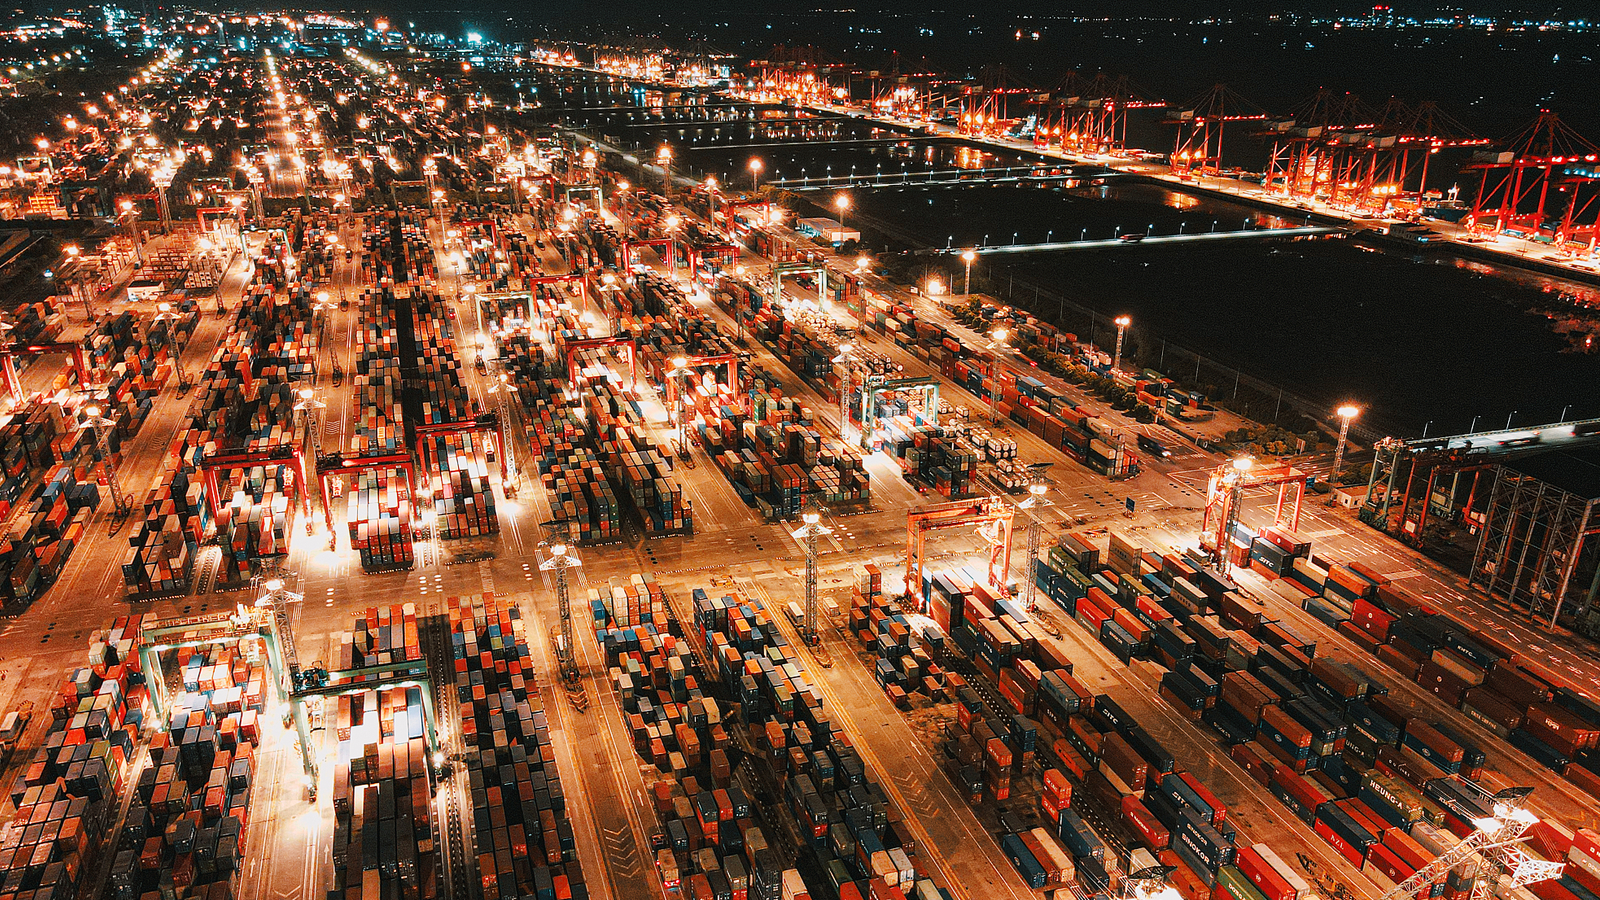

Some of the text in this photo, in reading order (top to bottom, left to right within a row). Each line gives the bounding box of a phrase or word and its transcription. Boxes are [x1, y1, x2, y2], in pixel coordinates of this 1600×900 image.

[1258, 556, 1275, 568] SITC
[1457, 645, 1474, 657] KMTC
[1102, 708, 1119, 726] SITC
[1345, 739, 1365, 757] UNG-A
[1172, 791, 1190, 808] SITC
[1369, 780, 1403, 810] HEUNG-A
[1479, 792, 1496, 807] HEU
[1186, 823, 1208, 846] SINOKOR
[1181, 832, 1210, 865] SINOKOR
